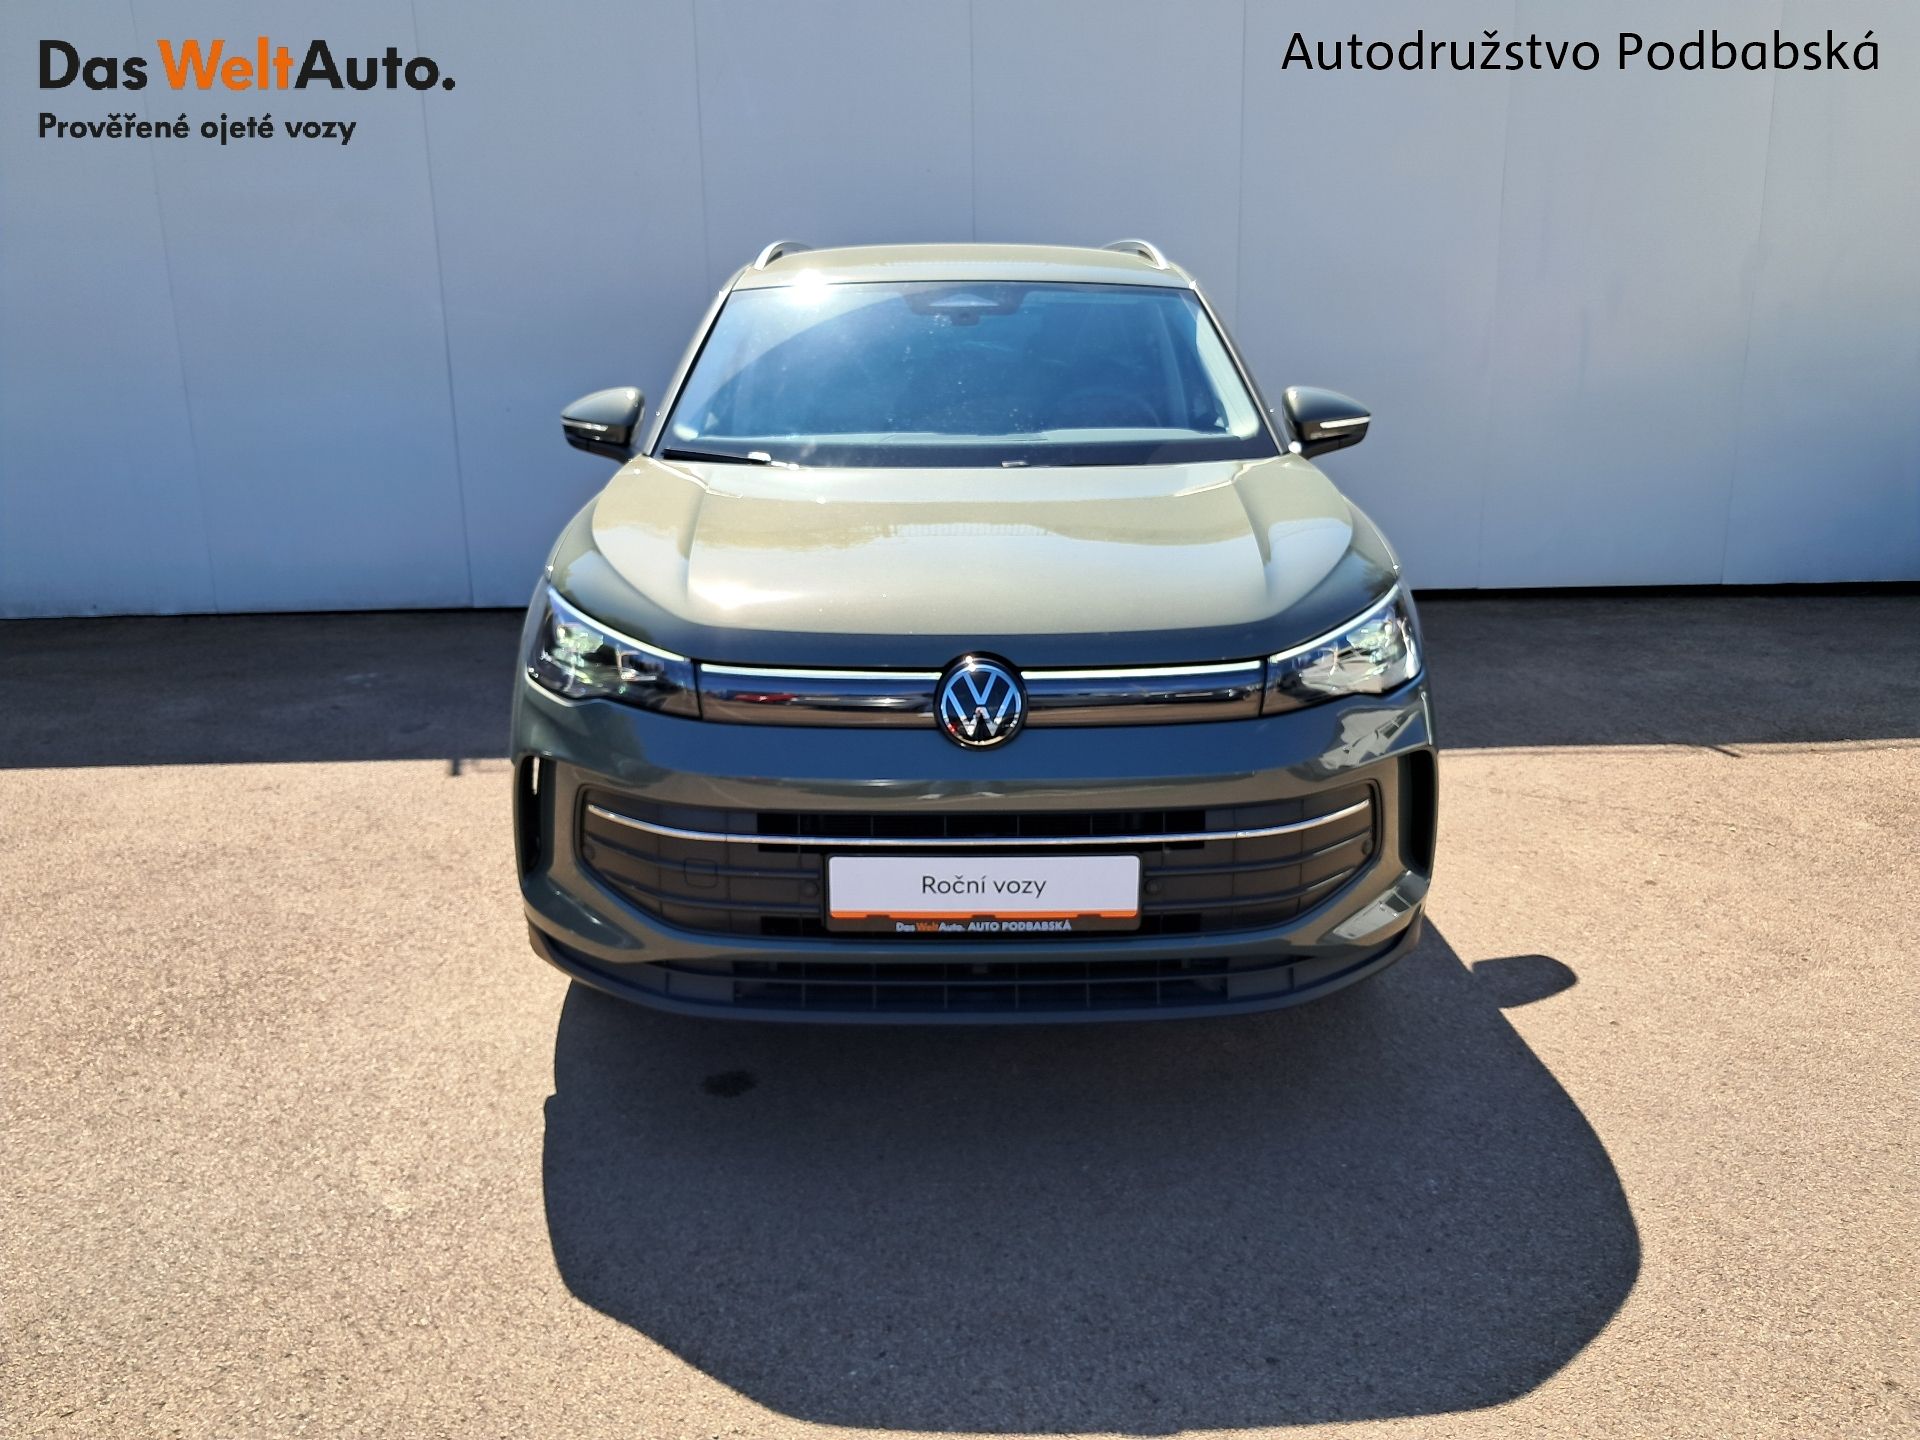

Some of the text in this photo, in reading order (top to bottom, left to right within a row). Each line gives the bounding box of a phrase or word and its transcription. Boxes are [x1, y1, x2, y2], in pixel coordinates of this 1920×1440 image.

[921, 874, 1047, 899] Roční vozy
[895, 921, 916, 932] Das
[967, 921, 1000, 932] AUTO
[1001, 919, 1072, 932] PODBABSKÁ
